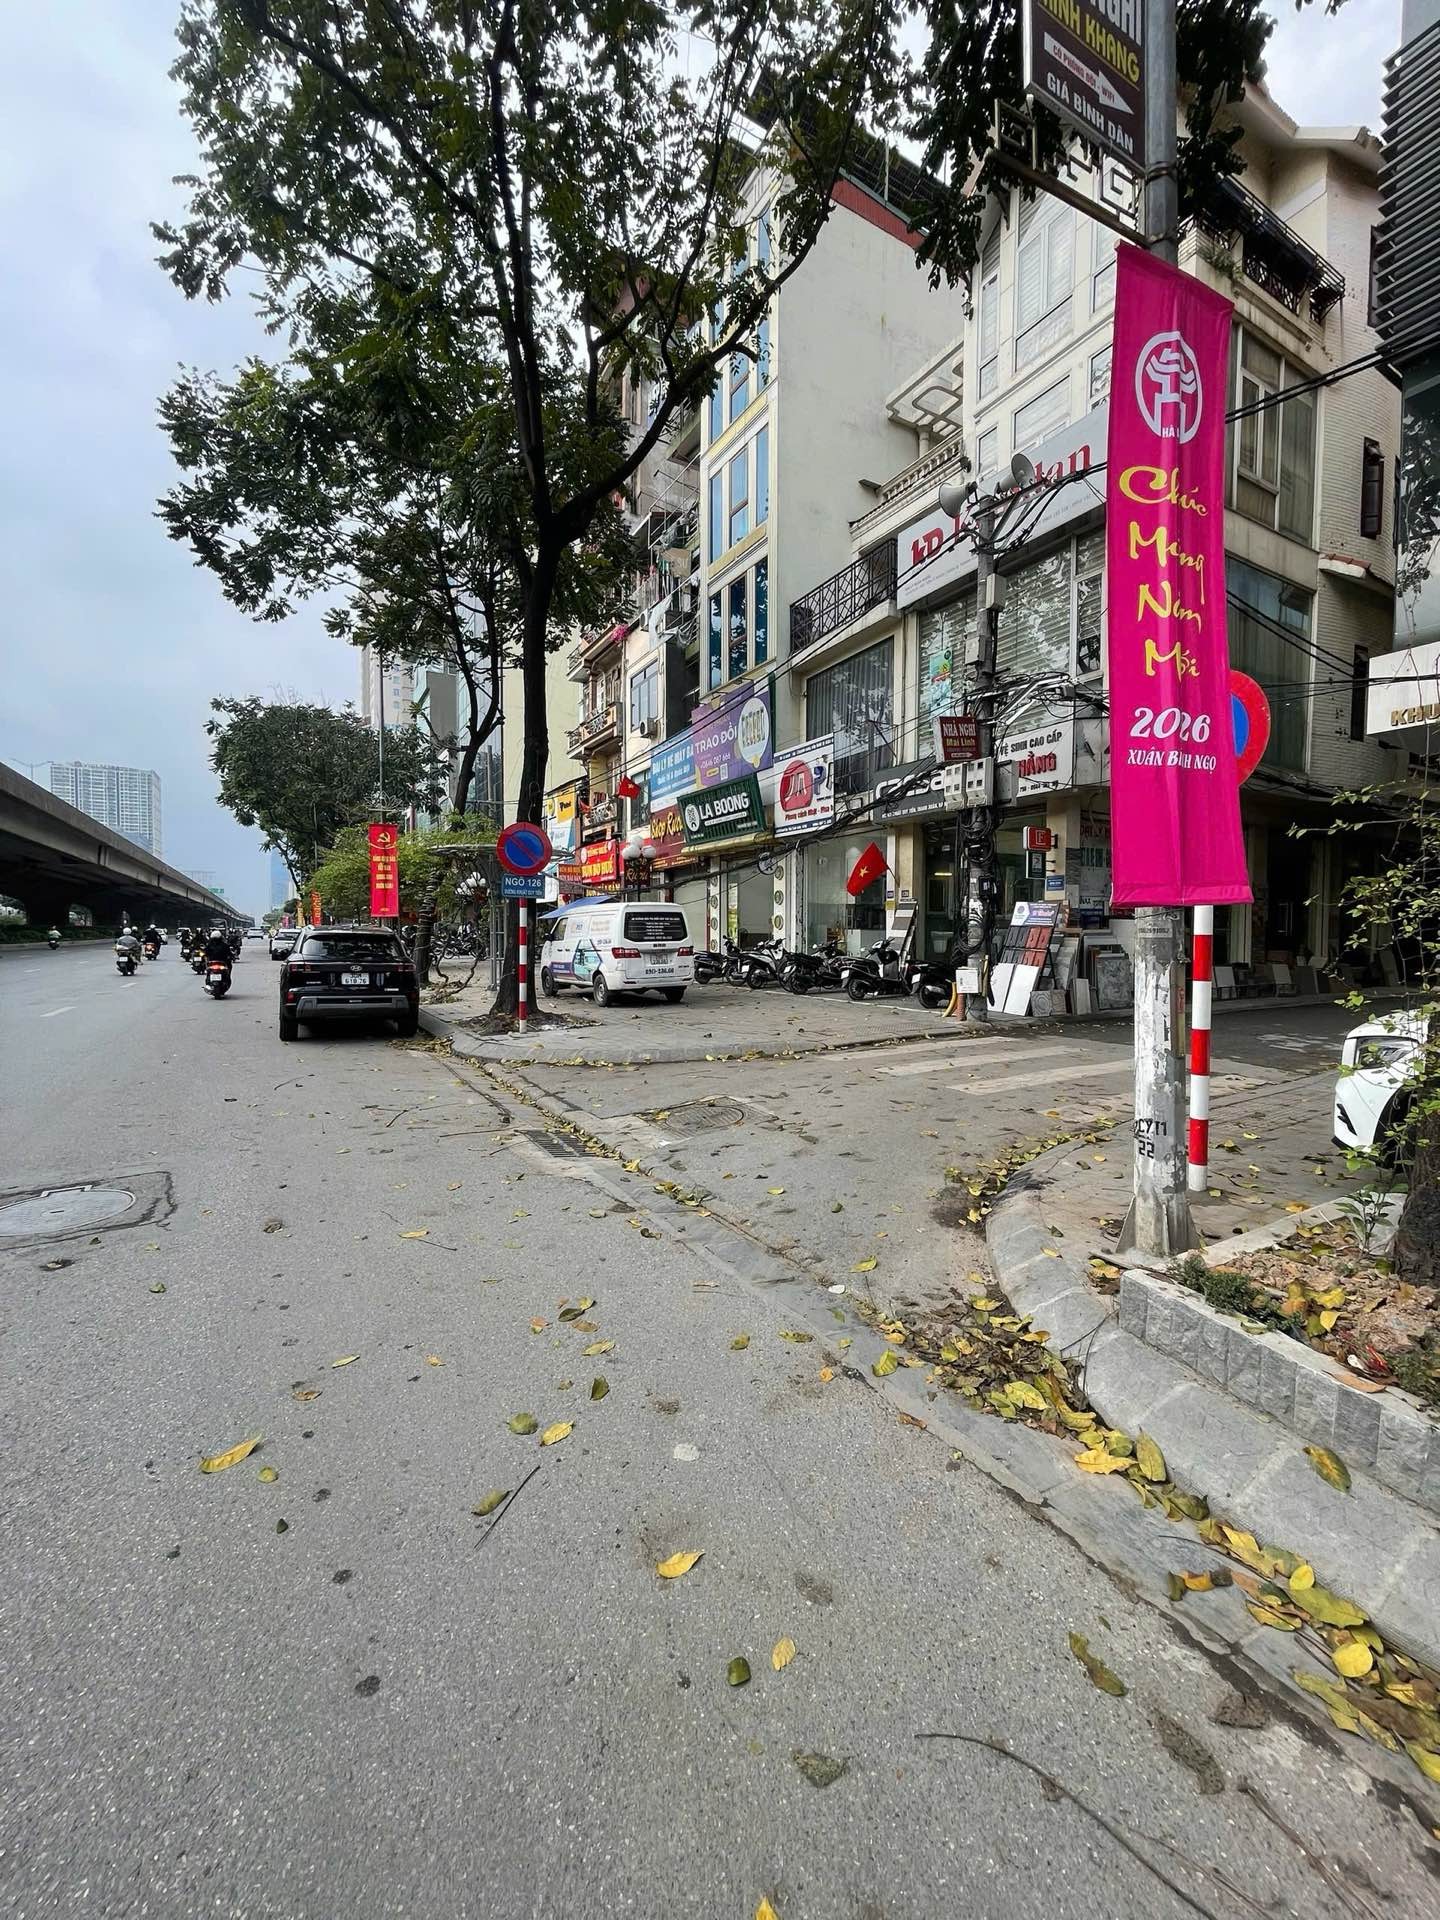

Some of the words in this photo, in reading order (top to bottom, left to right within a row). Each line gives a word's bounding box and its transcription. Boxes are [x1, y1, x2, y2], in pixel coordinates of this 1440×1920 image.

[1086, 13, 1140, 83] KHANG
[1047, 72, 1069, 104] GIÁ
[1073, 92, 1104, 132] BÌNH
[1107, 119, 1134, 154] DÂN
[943, 719, 958, 737] NHÀ
[959, 719, 976, 737] NGHỈ
[1130, 706, 1211, 743] 2026
[695, 736, 719, 754] TRAO
[1029, 736, 1045, 749] CAO
[1046, 729, 1063, 744] CẤP
[1127, 747, 1165, 766] XUÂN
[1194, 755, 1217, 775] NGỌ
[699, 803, 714, 820] LA
[713, 792, 750, 817] BOONG
[528, 879, 542, 887] 126
[1138, 1139, 1155, 1159] 22
